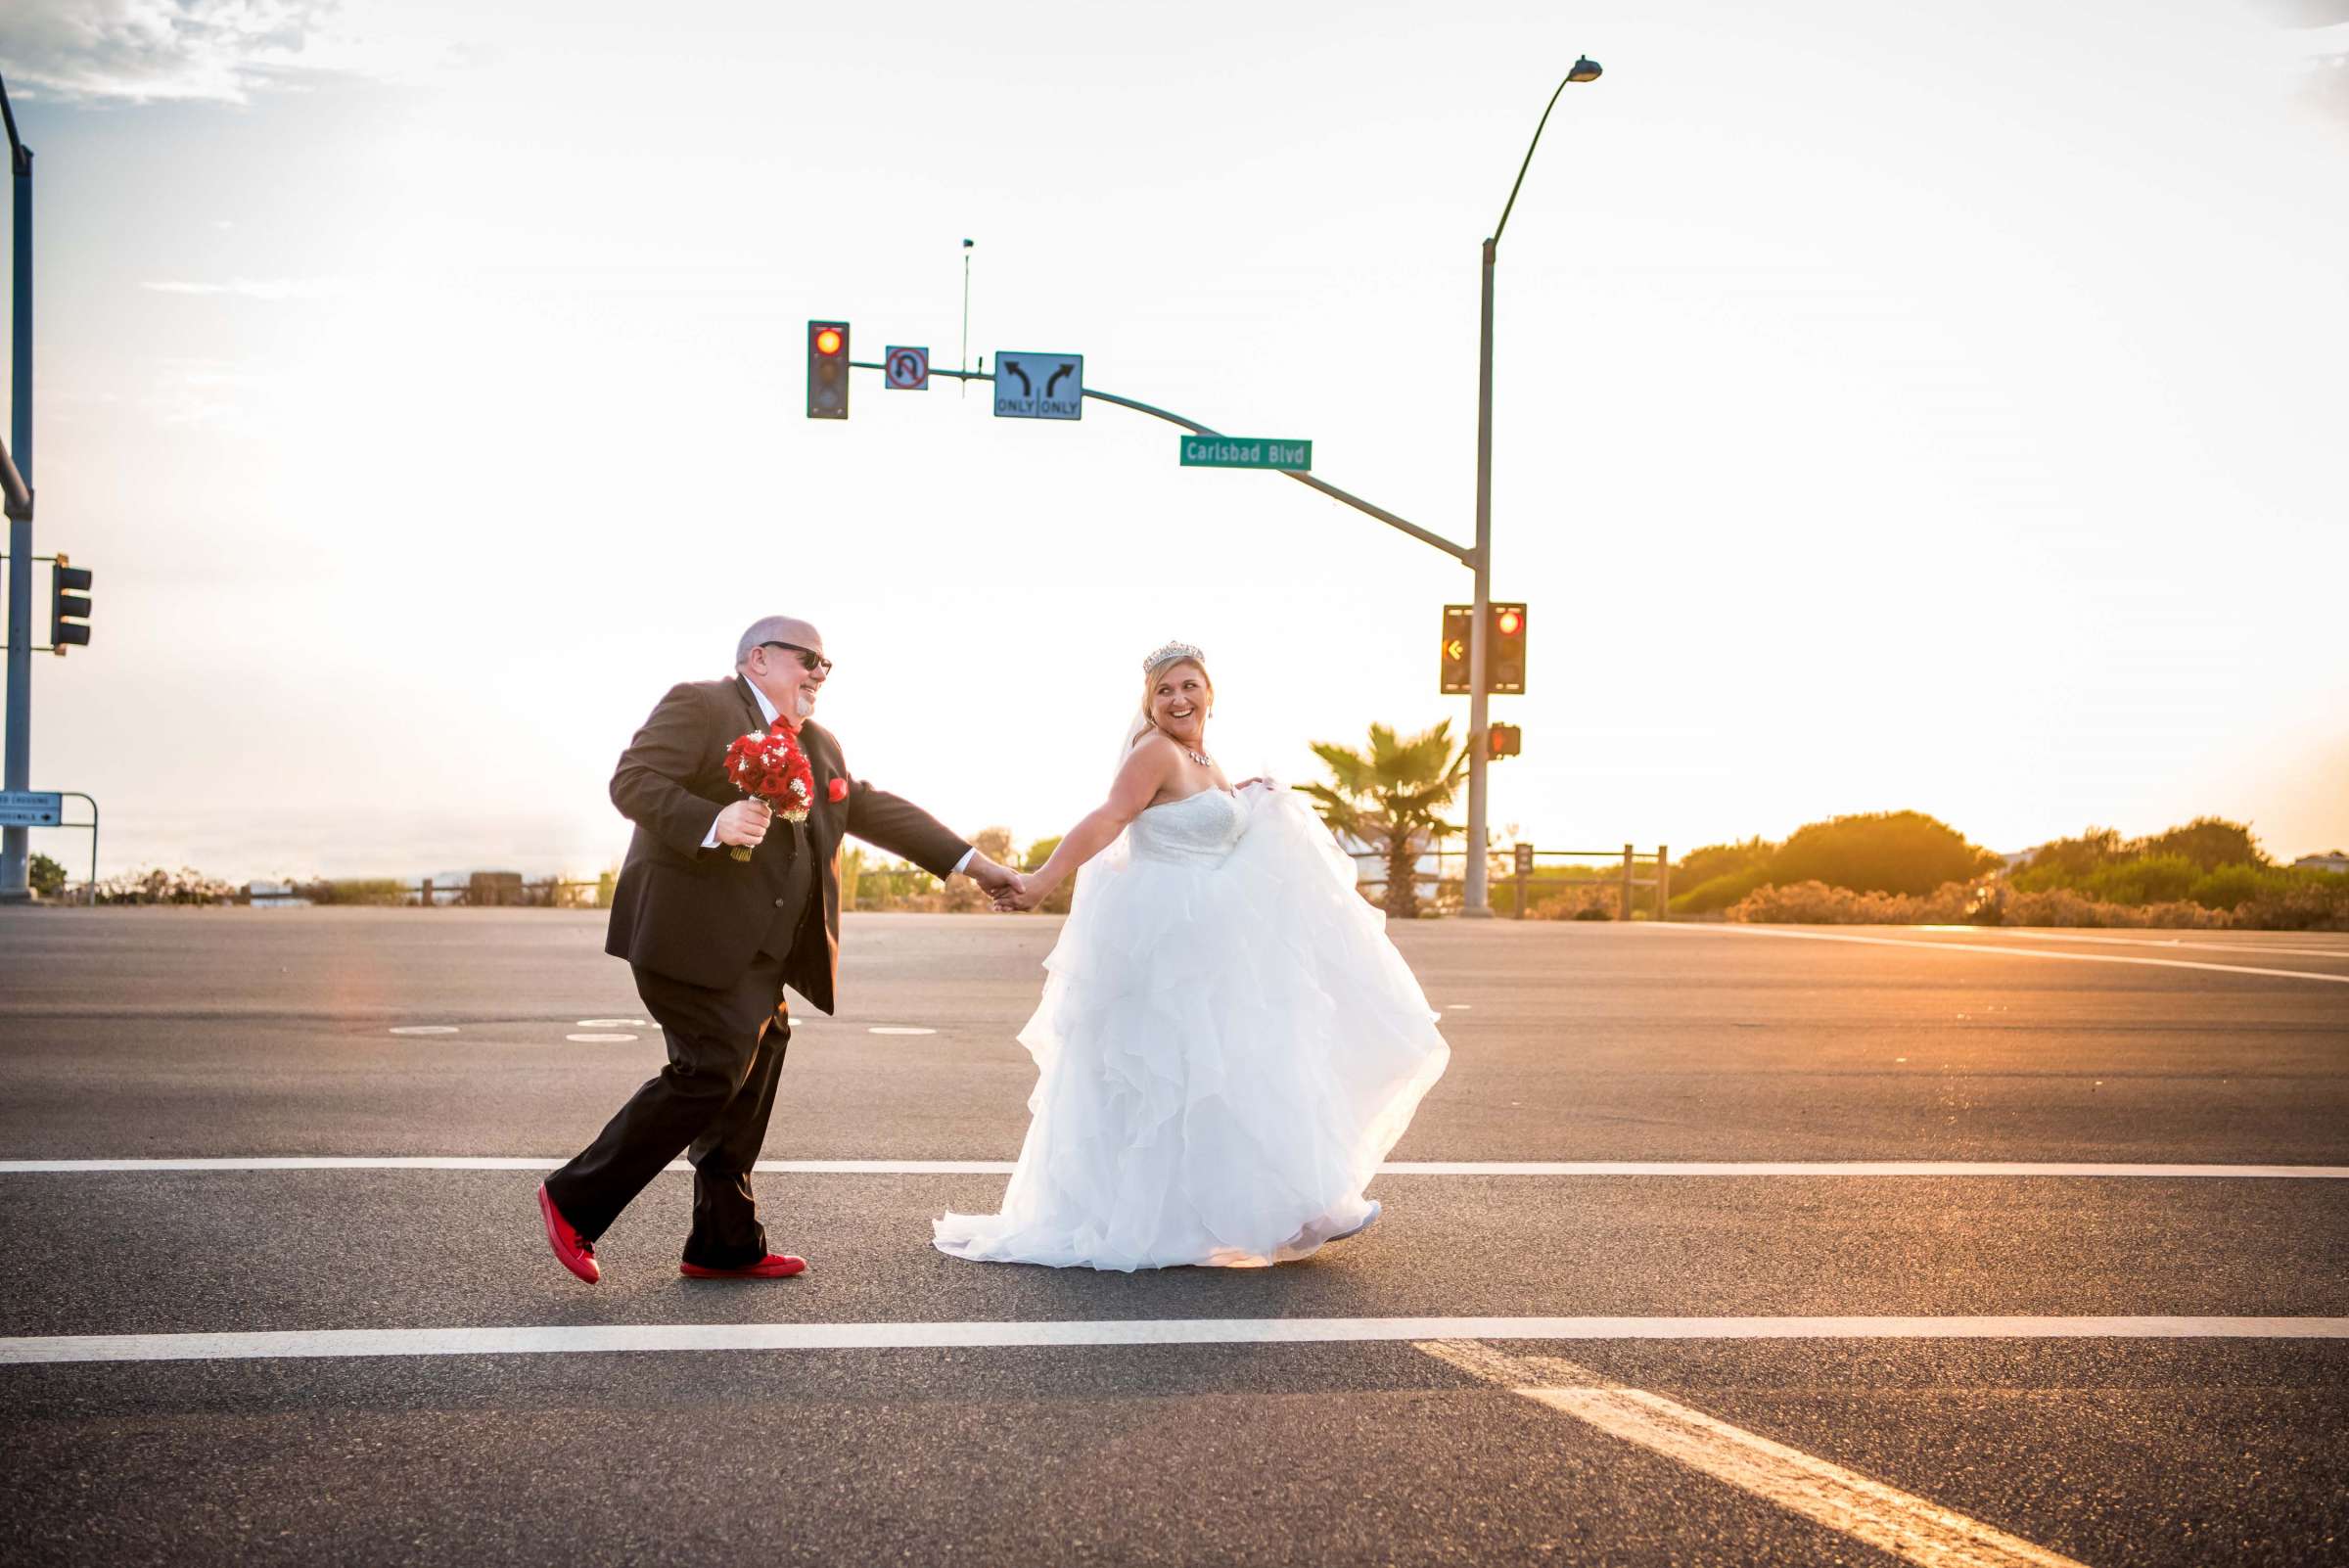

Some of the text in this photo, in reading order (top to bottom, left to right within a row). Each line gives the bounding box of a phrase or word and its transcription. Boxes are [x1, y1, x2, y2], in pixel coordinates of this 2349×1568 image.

[998, 398, 1079, 414] ONLY ONLY
[1186, 441, 1305, 464] Carlsbad Blvd
